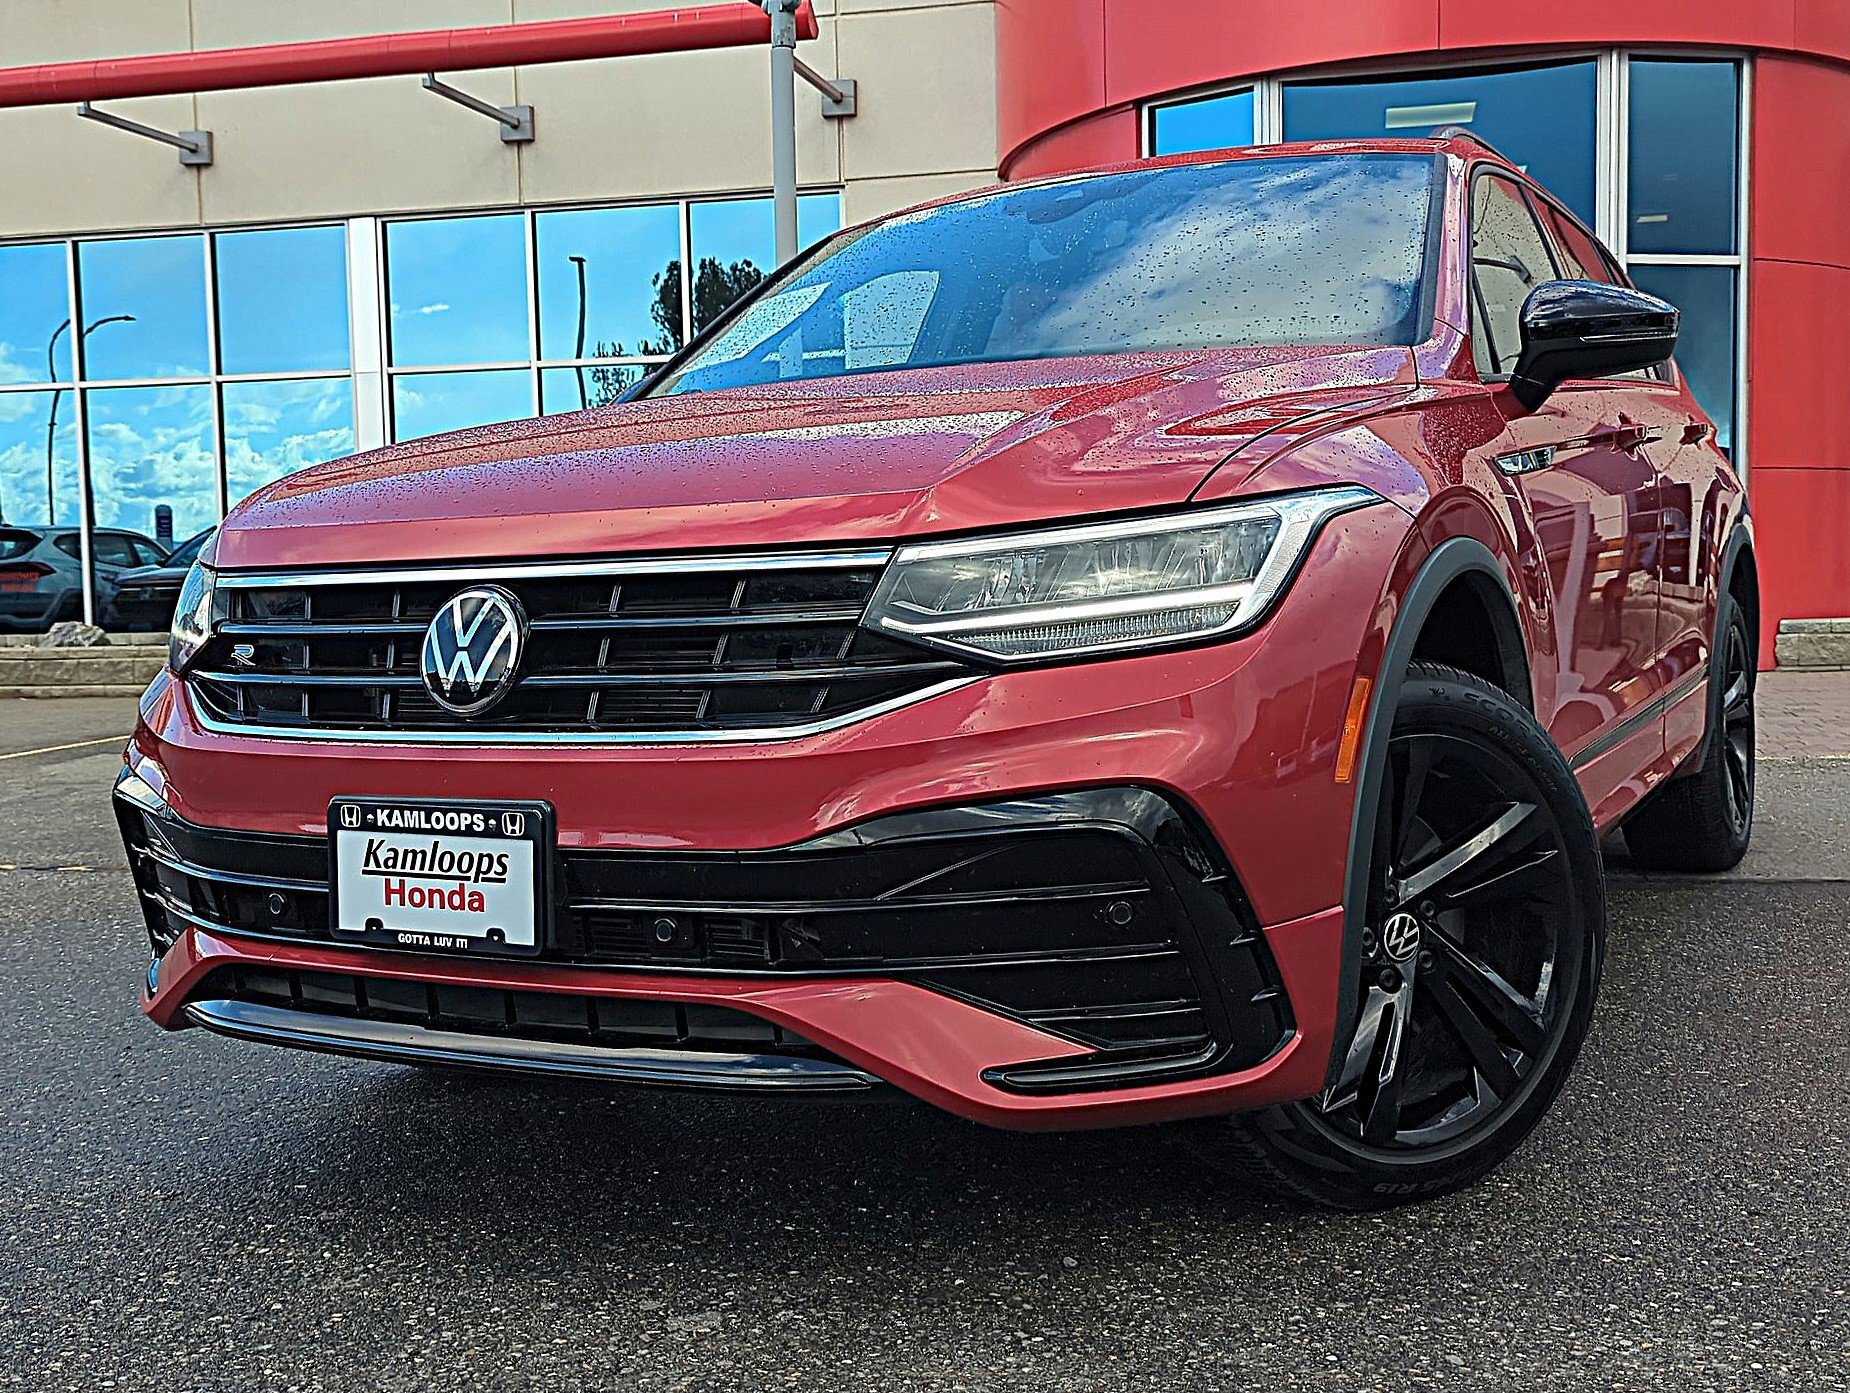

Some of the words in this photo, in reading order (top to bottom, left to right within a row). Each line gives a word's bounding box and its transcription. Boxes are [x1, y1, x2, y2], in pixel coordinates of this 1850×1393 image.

[376, 808, 485, 832] KAMLOOPS
[362, 838, 510, 884] Kamloops
[384, 877, 485, 913] Honda
[397, 932, 431, 946] GOTTA
[433, 935, 453, 947] LUV
